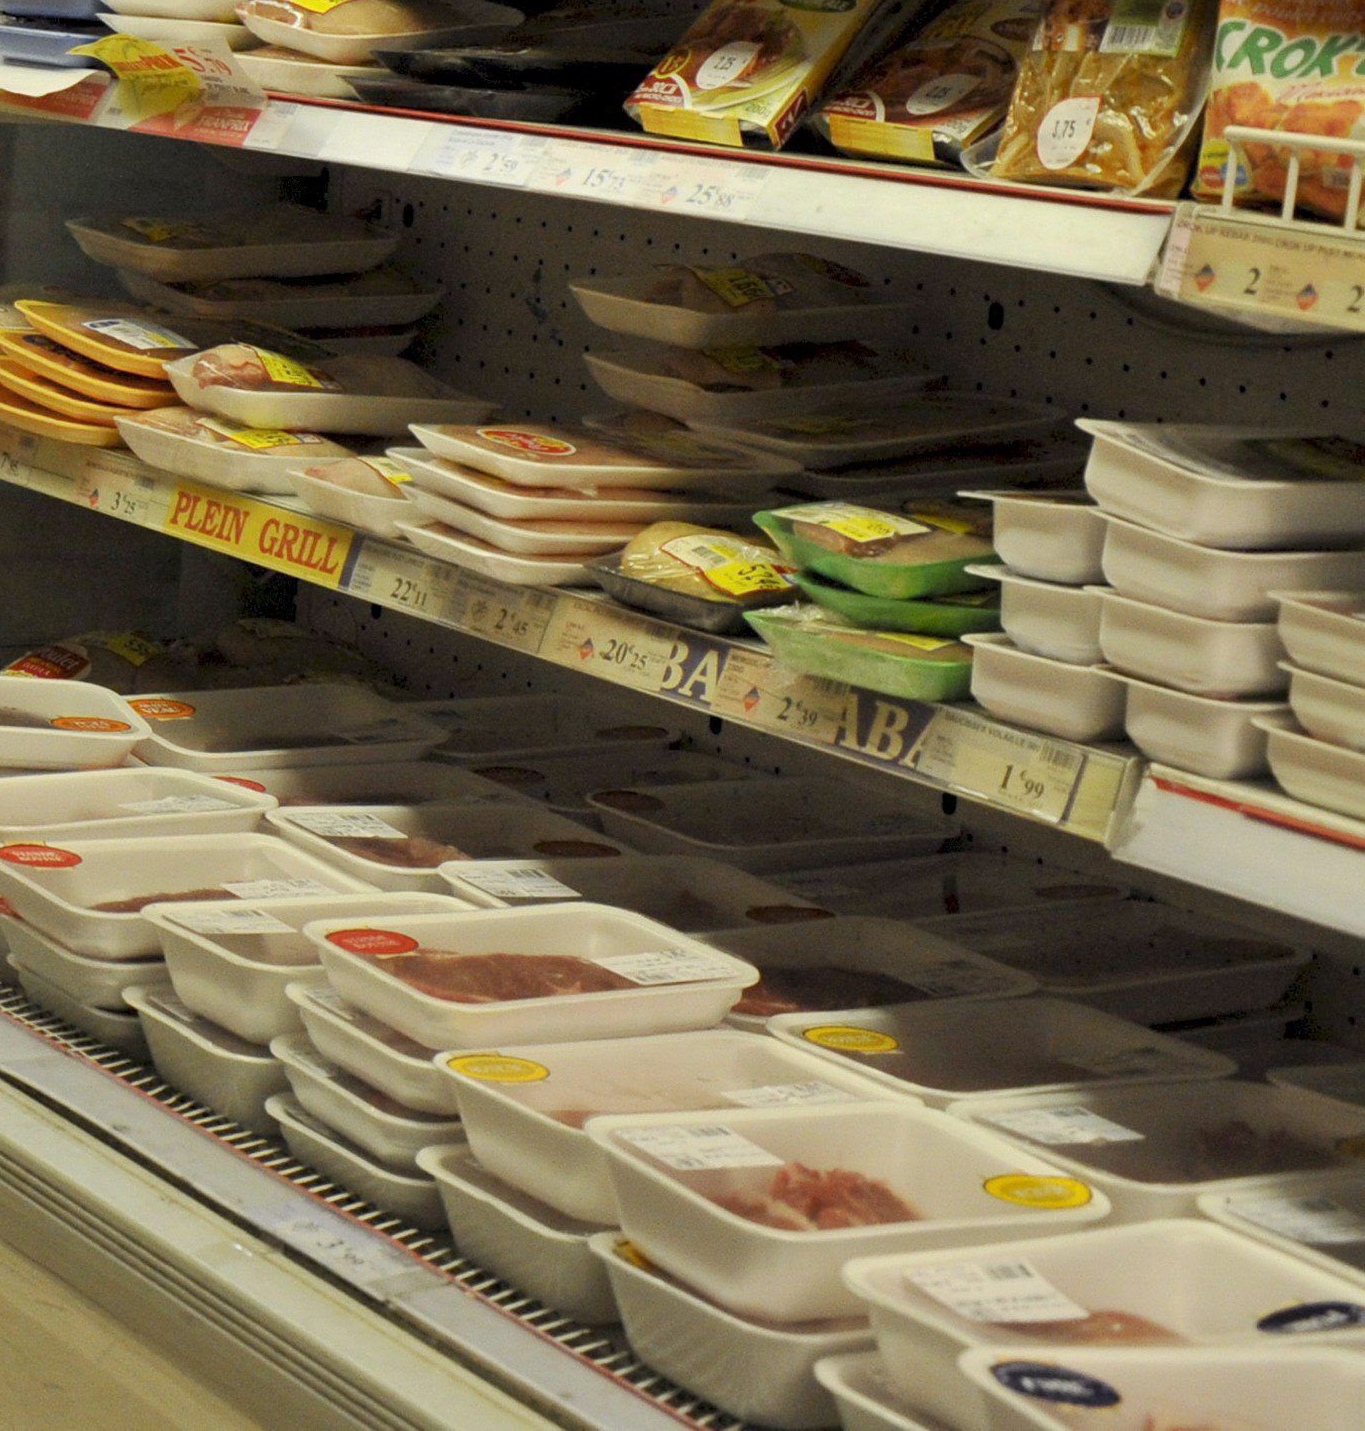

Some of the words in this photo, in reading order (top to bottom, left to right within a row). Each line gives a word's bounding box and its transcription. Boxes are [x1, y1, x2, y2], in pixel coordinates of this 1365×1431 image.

[1243, 266, 1262, 296] 2
[168, 490, 249, 546] PLEIN
[256, 518, 341, 576] GRILL
[997, 762, 1045, 799] 1€99
